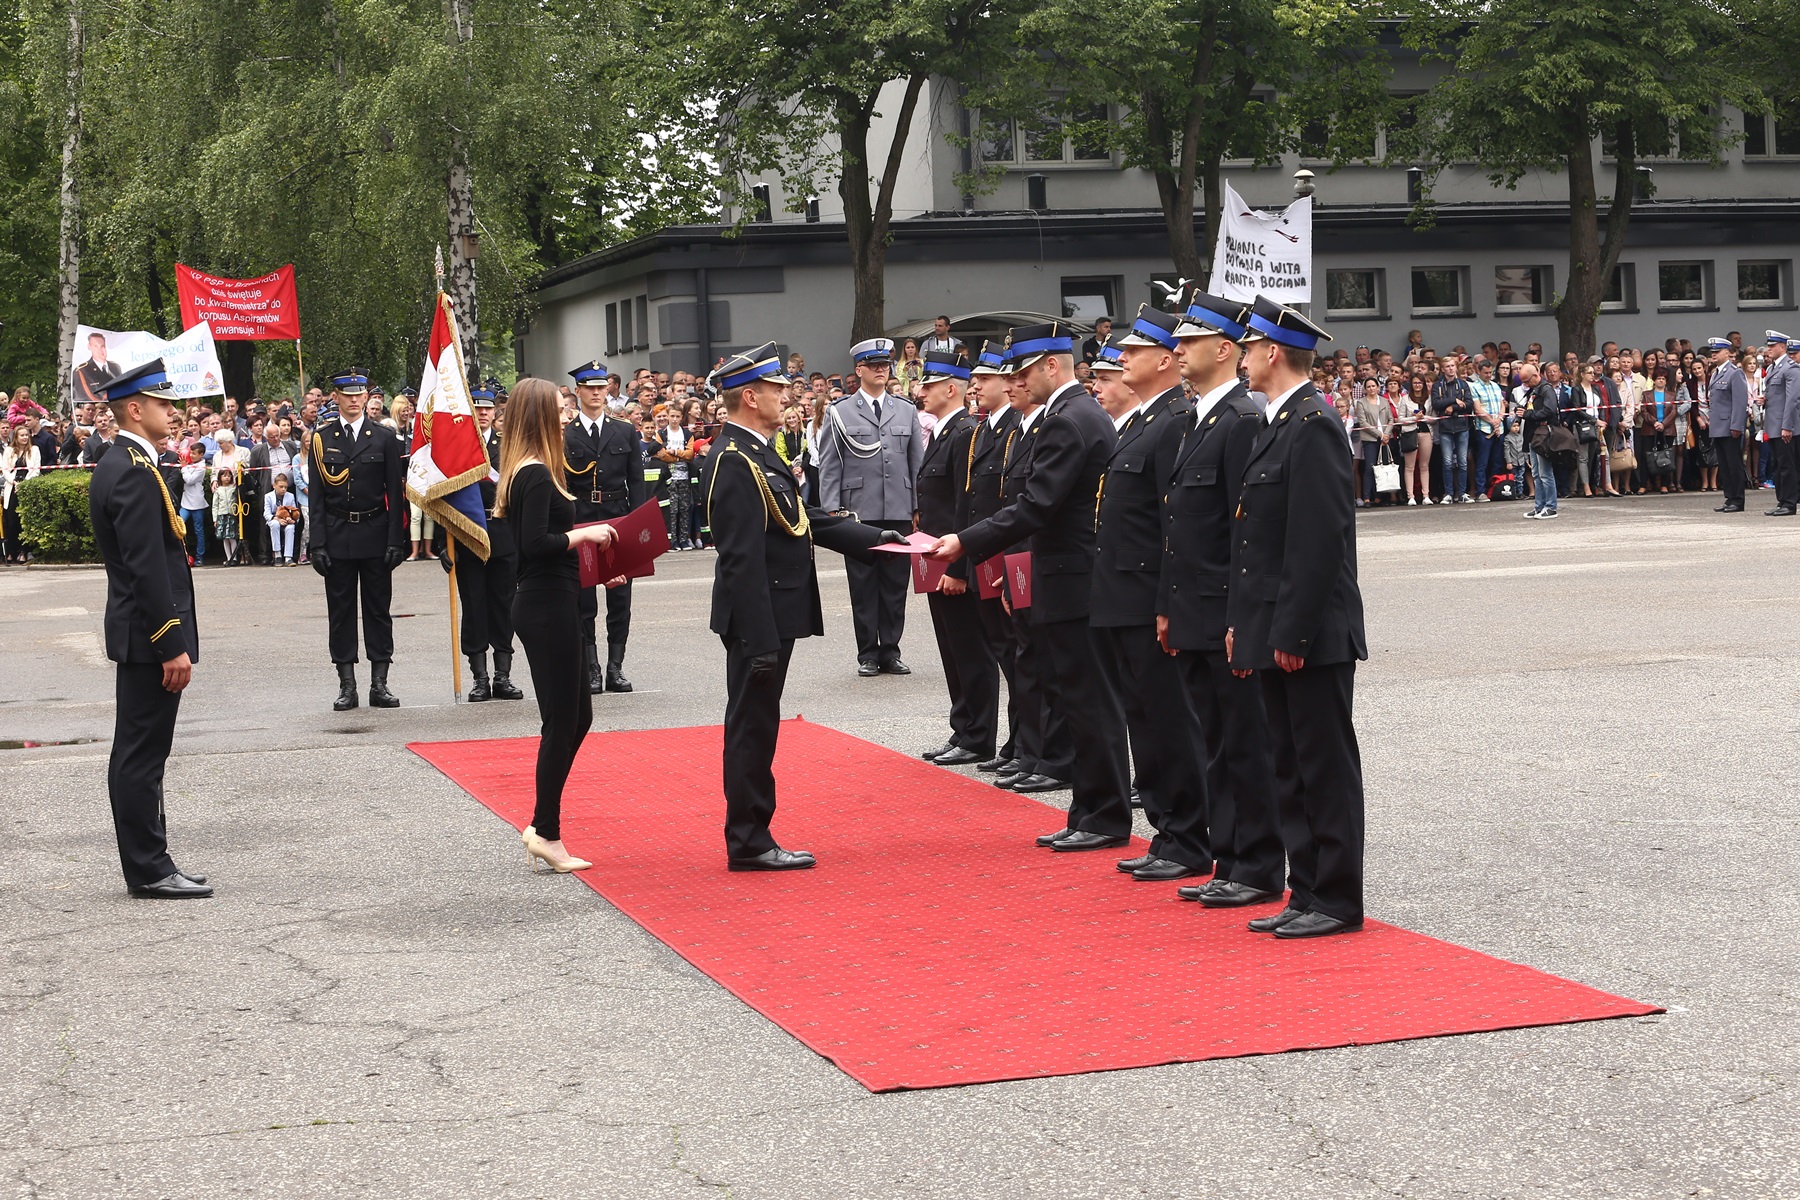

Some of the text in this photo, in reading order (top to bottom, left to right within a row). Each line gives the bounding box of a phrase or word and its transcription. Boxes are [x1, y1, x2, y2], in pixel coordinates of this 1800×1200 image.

[1270, 261, 1300, 275] WITA
[1260, 275, 1307, 289] BOCIANA
[227, 289, 262, 301] świętuje
[194, 296, 206, 306] bo
[270, 299, 281, 309] do
[198, 310, 280, 324] korpusu Aspirantów
[215, 325, 255, 337] awansuje
[189, 340, 205, 352] od
